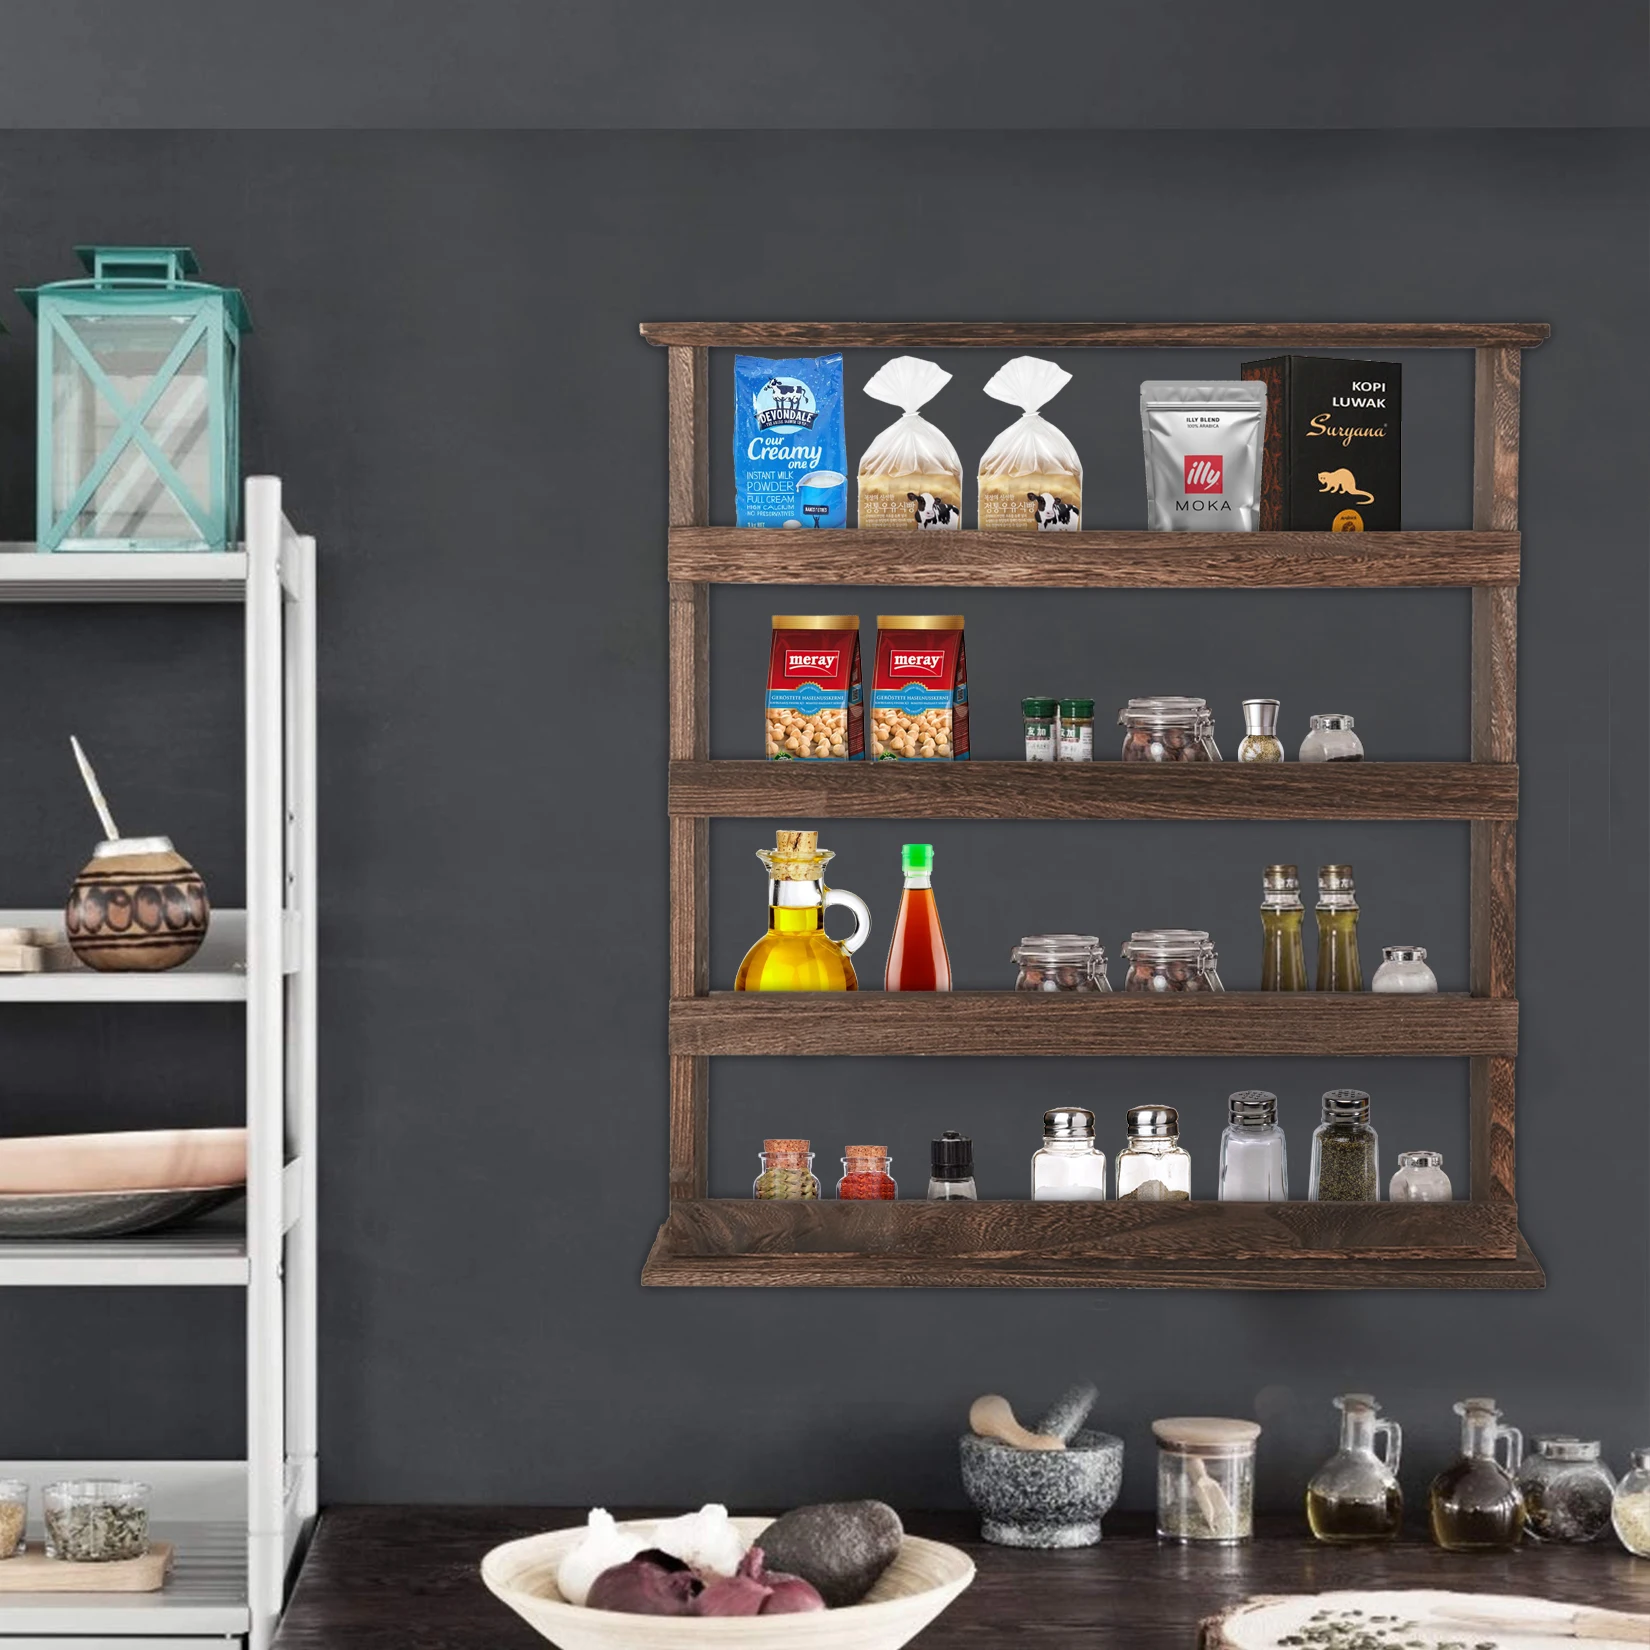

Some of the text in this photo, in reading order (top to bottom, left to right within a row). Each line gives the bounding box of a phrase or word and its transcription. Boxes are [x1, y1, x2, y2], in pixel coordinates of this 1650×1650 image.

[1352, 381, 1386, 392] KOPI
[1332, 397, 1386, 408] LUWAK
[760, 409, 813, 424] DEVONDALE
[1306, 413, 1387, 447] Suryana
[765, 437, 784, 446] our
[747, 437, 822, 469] Creamy
[788, 459, 807, 469] one
[747, 471, 794, 480] INSTANT MILK
[1187, 460, 1220, 491] illy
[747, 481, 794, 492] POWDER
[747, 496, 795, 504] FULL CREAM
[1175, 500, 1232, 511] MOKA
[789, 655, 835, 669] meray
[894, 655, 940, 669] meray
